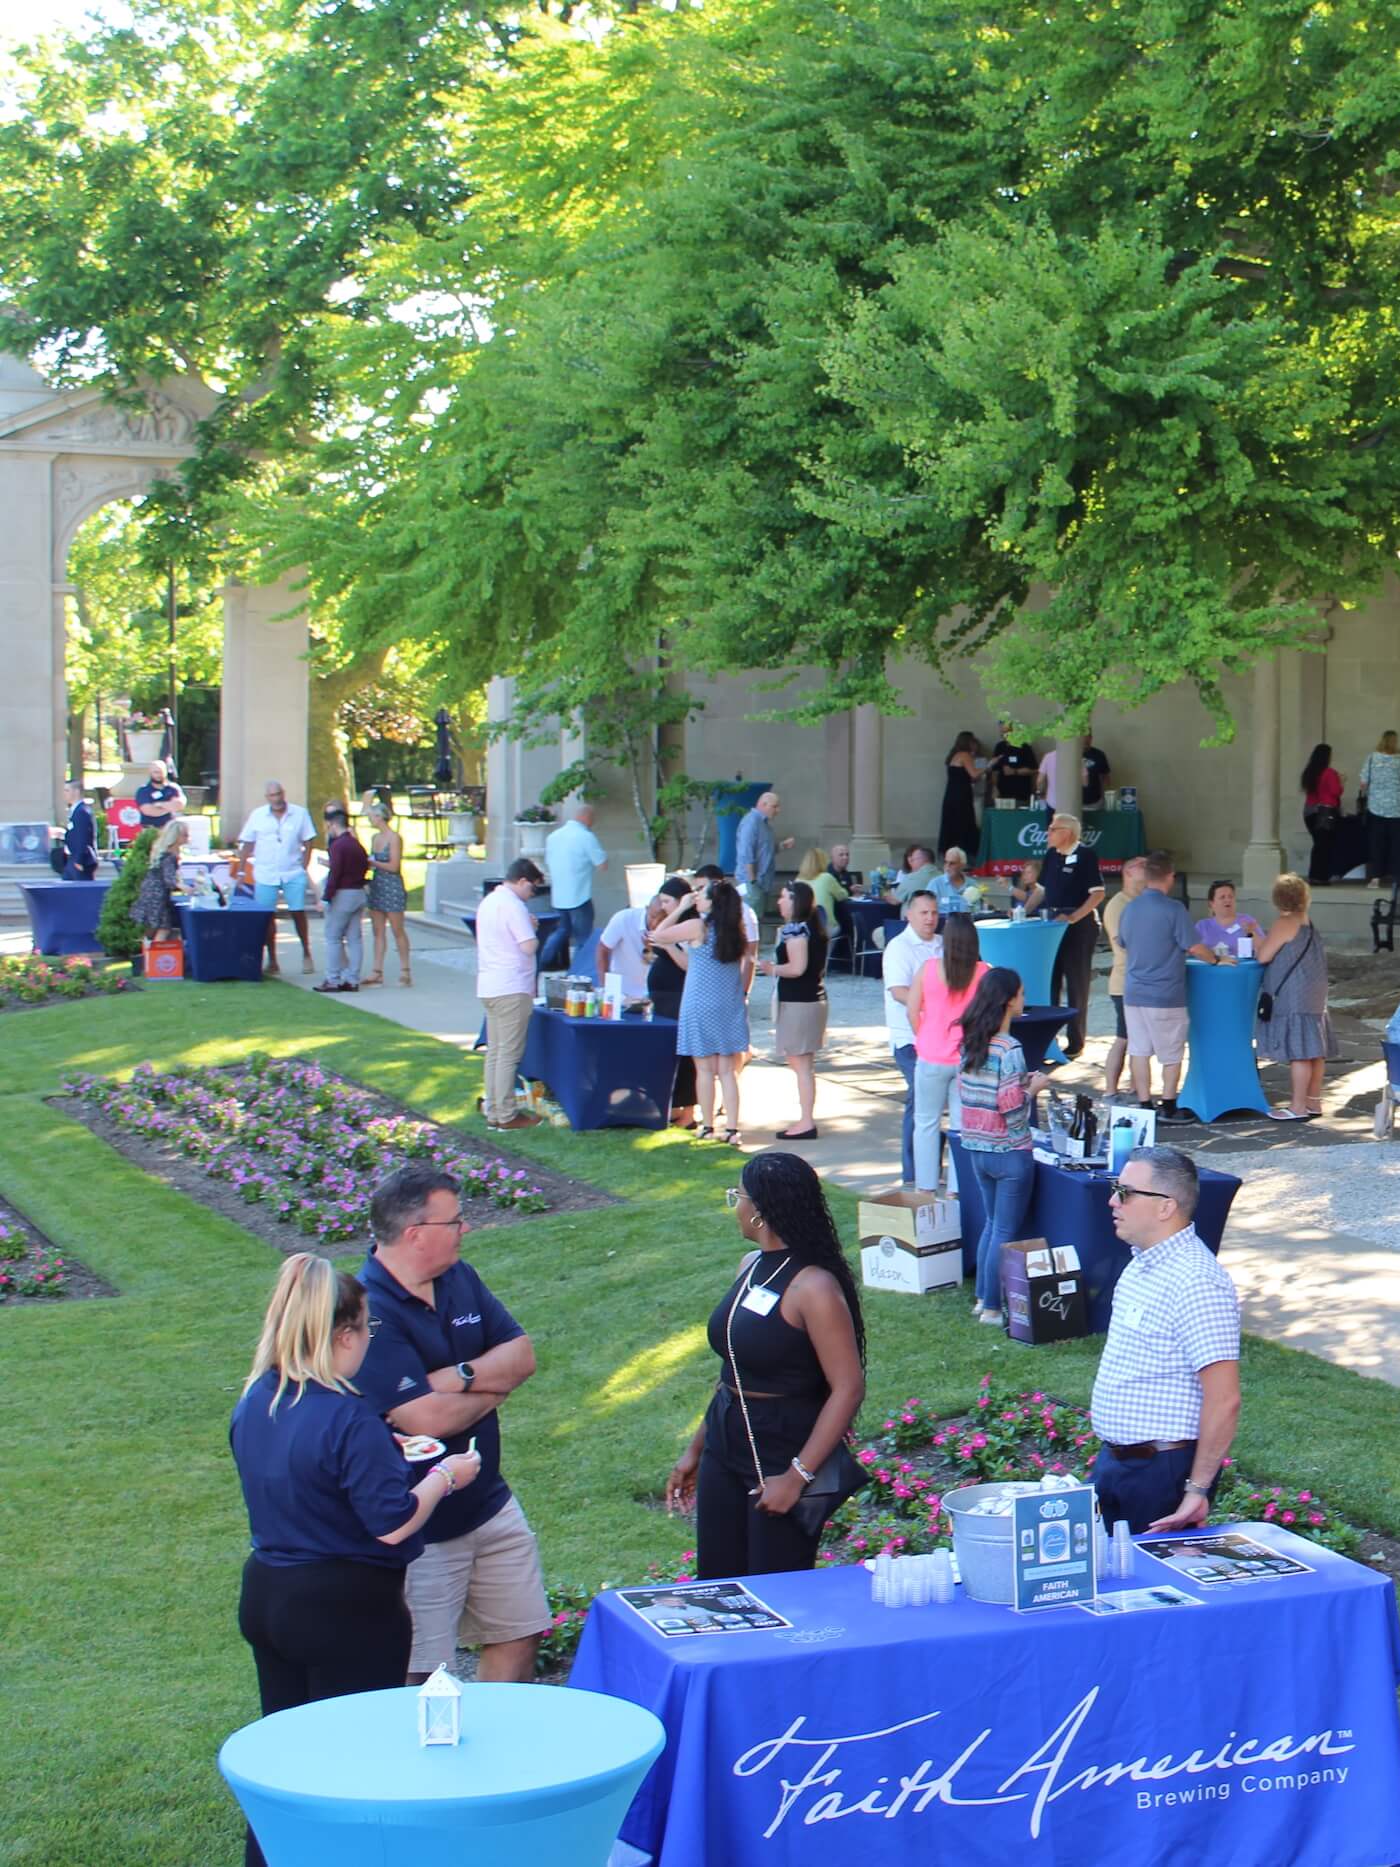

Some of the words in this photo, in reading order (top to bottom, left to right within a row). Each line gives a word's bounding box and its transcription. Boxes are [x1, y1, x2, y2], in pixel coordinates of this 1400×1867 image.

[1032, 1589, 1079, 1603] AMERICAN
[1042, 1580, 1069, 1591] FAITH
[733, 1710, 1029, 1838] Faith
[997, 1686, 1355, 1839] American
[1136, 1782, 1231, 1809] Brewing
[1241, 1766, 1349, 1794] Company
